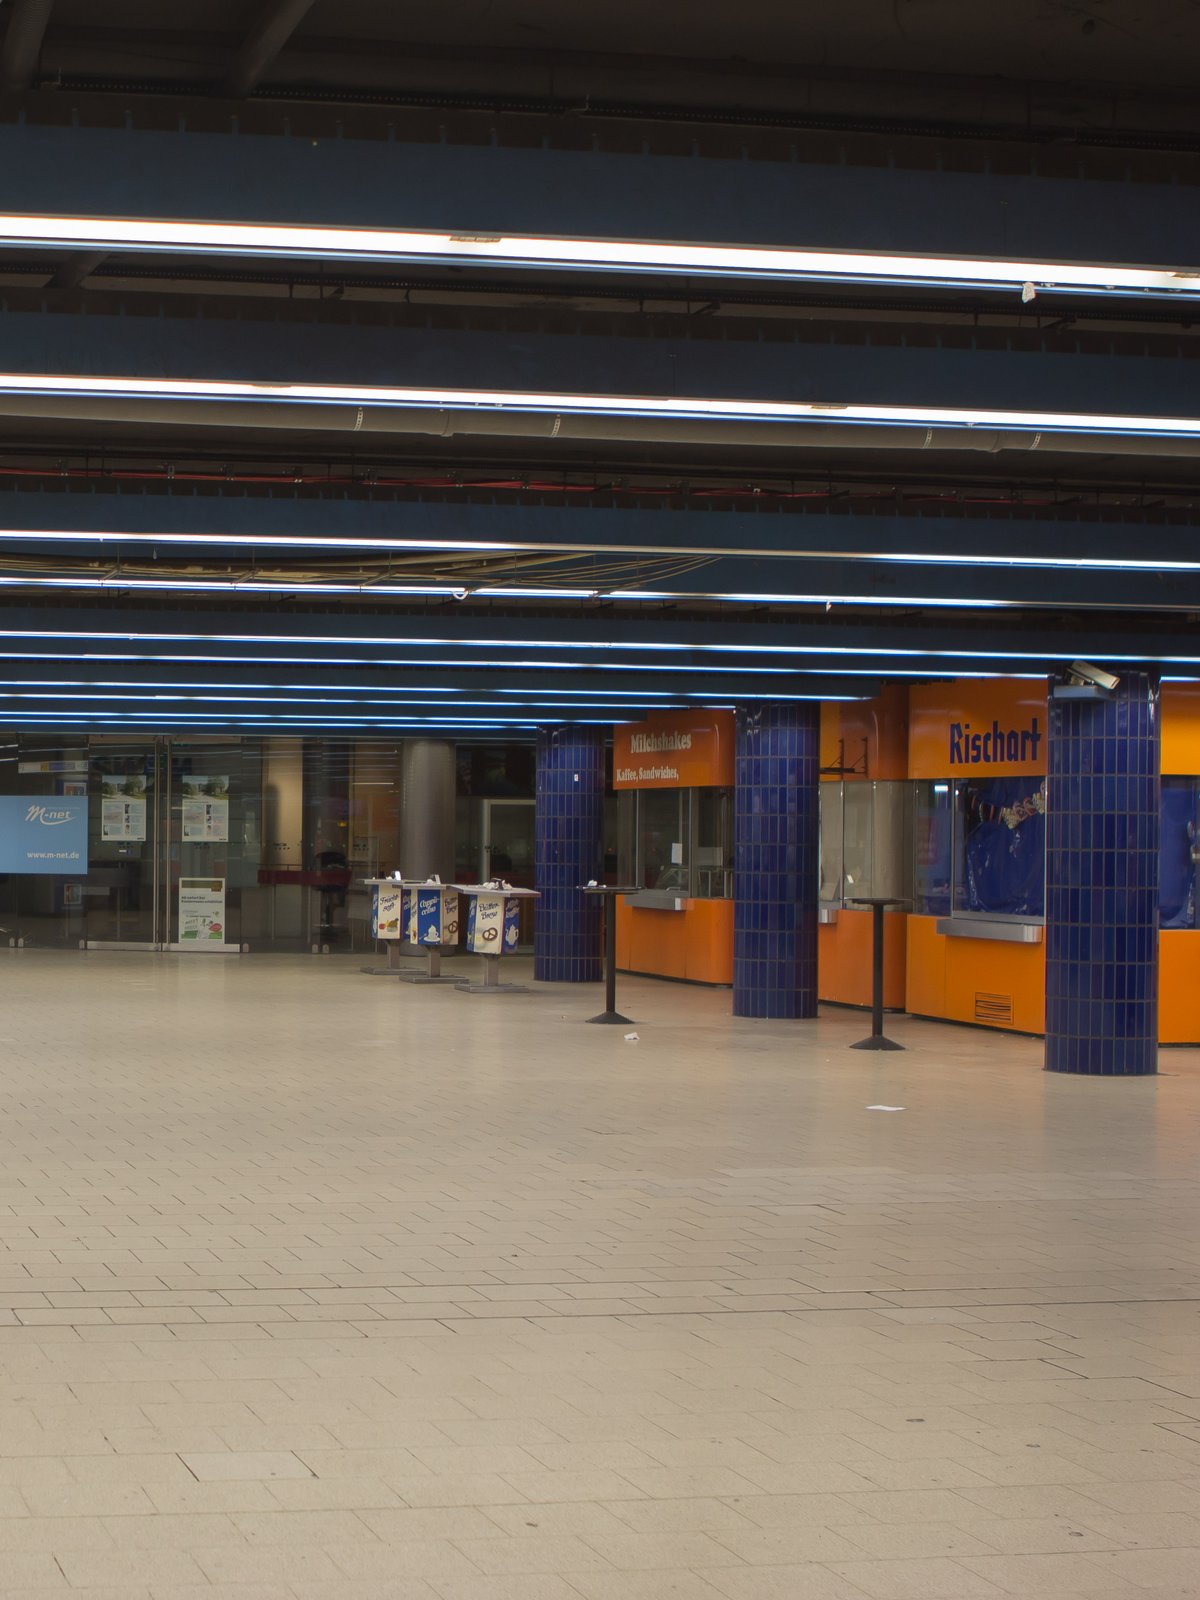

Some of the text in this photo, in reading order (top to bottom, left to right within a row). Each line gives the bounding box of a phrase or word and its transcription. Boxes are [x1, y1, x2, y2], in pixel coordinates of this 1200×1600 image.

[631, 731, 692, 753] Milchshakes
[950, 718, 1041, 764] Rischart
[617, 766, 679, 782] Kaffee, Sandwiches,
[25, 805, 73, 823] M-net
[26, 851, 80, 859] www.m-net.de
